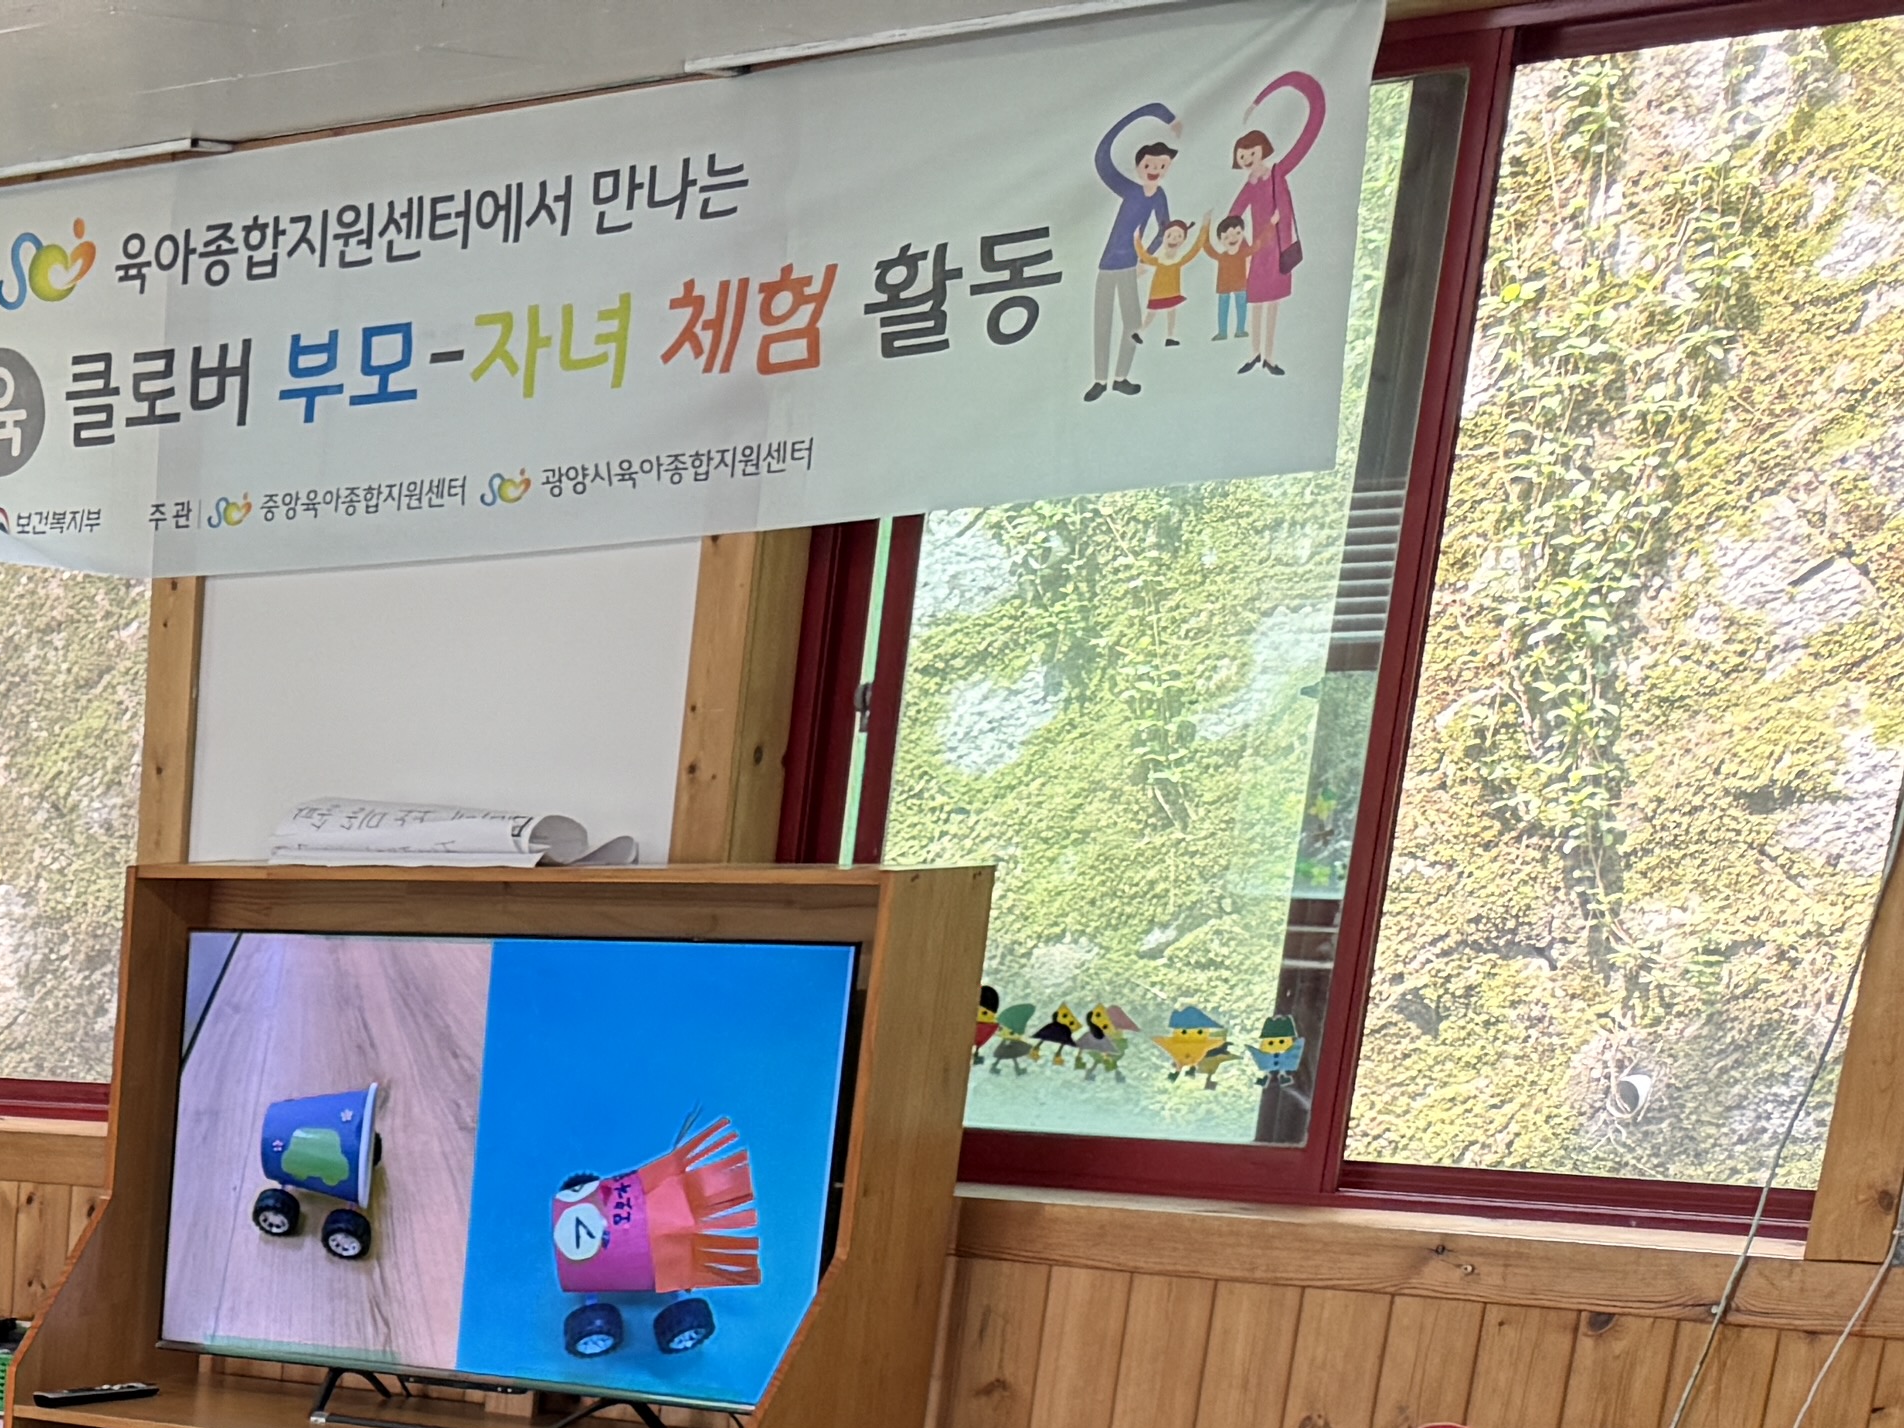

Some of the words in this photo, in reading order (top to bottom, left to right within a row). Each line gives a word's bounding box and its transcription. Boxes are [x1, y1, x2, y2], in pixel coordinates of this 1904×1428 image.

[113, 174, 574, 295] 육아종합지원센터에서
[592, 152, 750, 235] 만나는
[64, 337, 253, 448] 클로버
[278, 291, 633, 425] 부모-자녀
[660, 262, 839, 377] 체험
[863, 225, 1064, 360] 활동
[15, 507, 103, 536] 보건복지부
[259, 475, 467, 523] 중앙육아종합지원센터
[540, 437, 815, 498] 광양시육아종합지원센터
